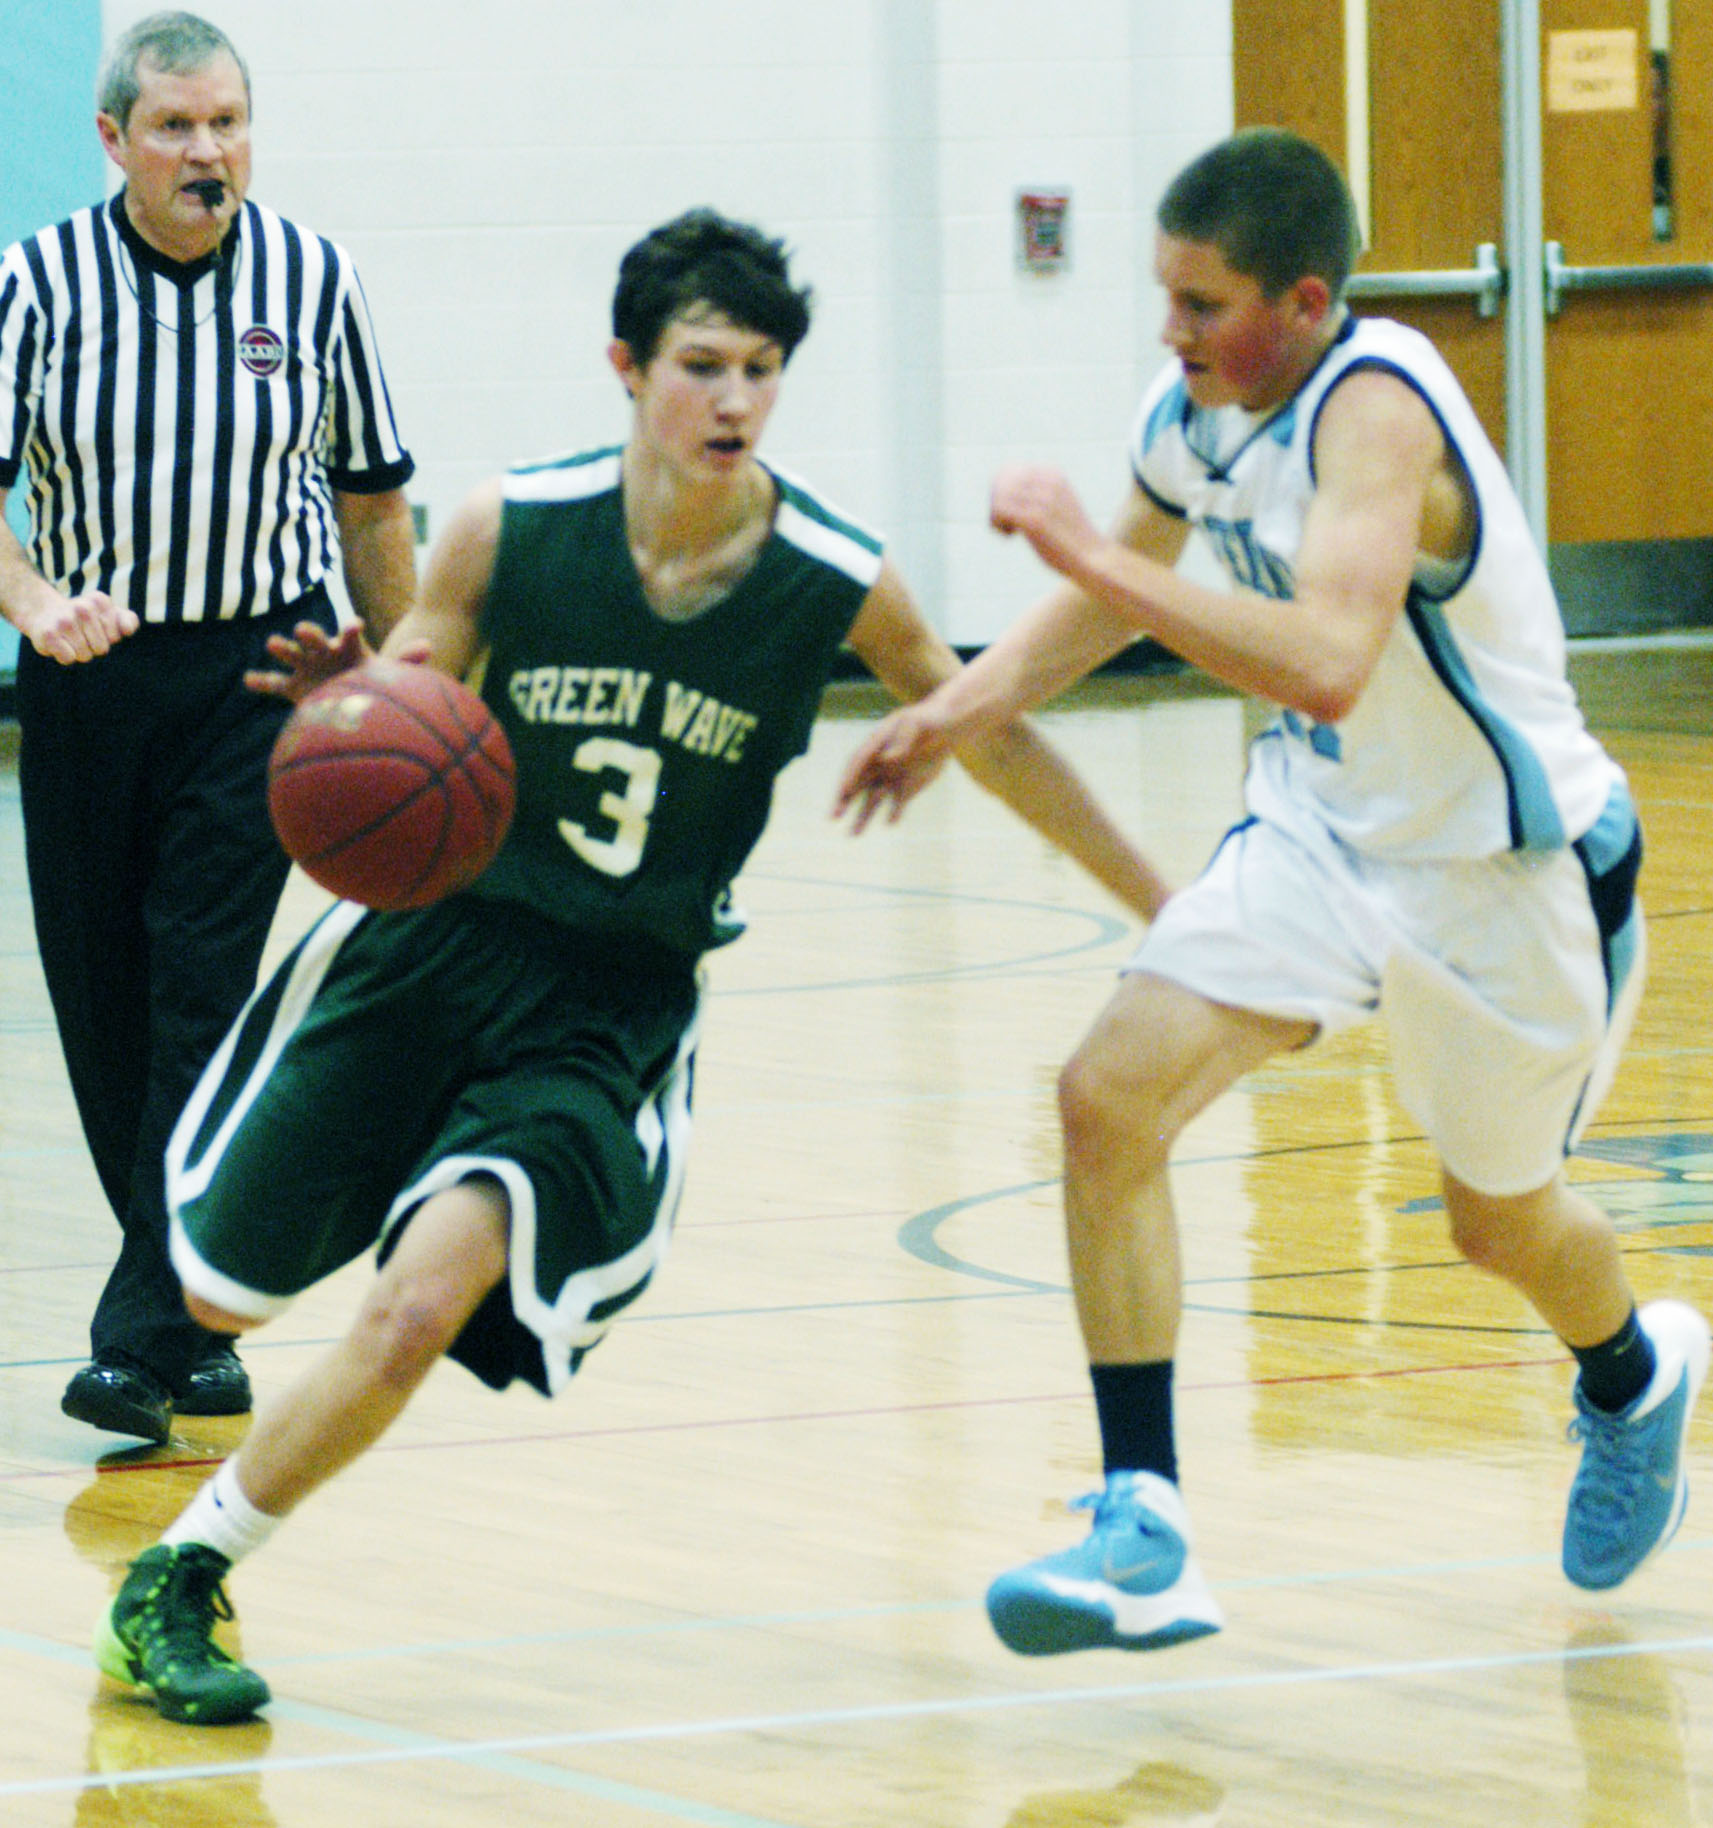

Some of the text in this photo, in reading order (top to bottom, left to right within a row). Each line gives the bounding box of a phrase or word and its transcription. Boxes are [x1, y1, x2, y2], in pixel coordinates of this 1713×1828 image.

[509, 666, 758, 763] GREEN WAVE
[558, 736, 663, 878] 3
